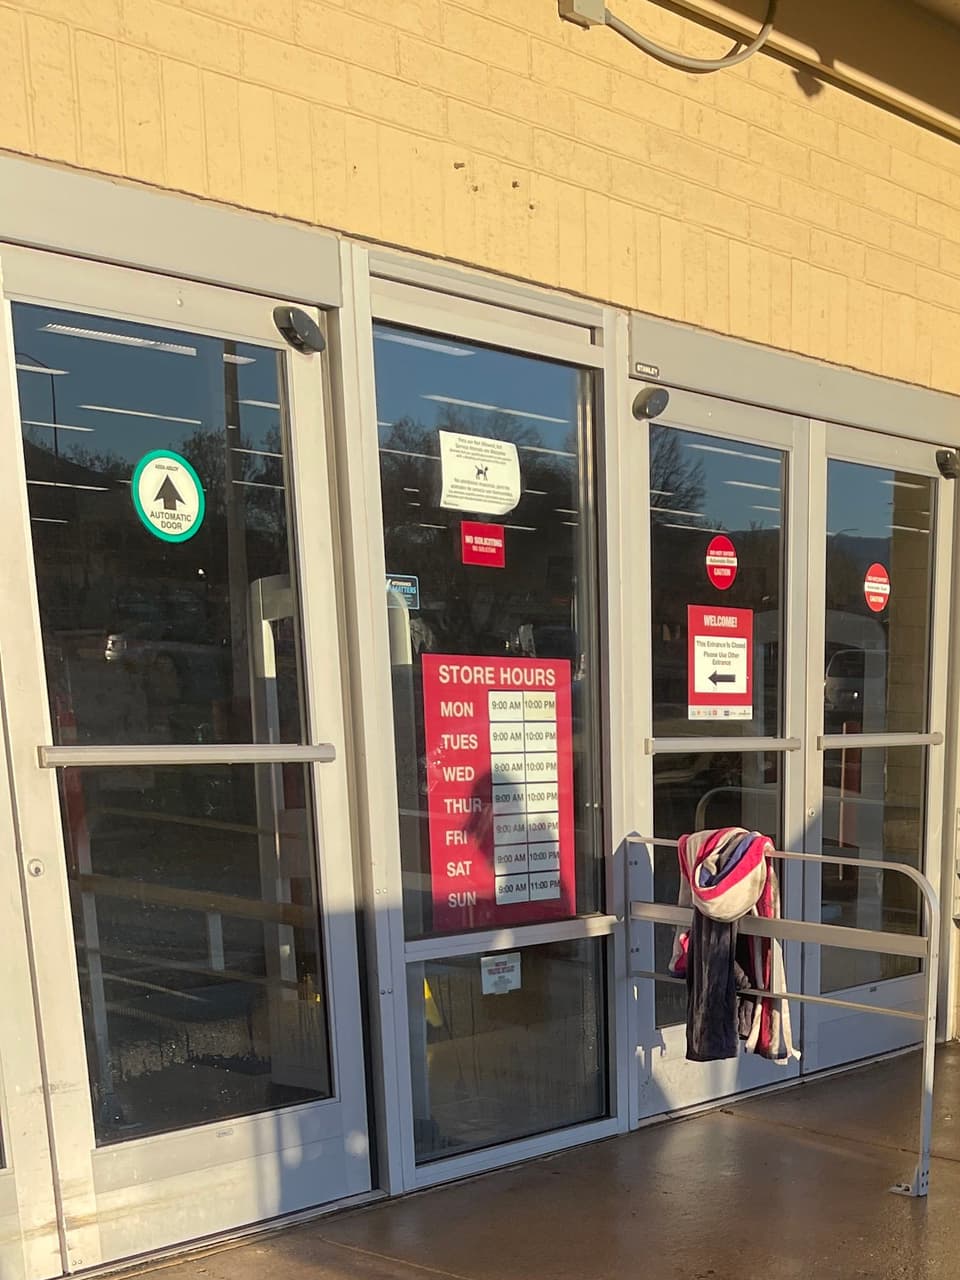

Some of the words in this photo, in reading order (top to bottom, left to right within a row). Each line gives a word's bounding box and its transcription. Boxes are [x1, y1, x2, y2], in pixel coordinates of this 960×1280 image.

[637, 364, 659, 376] STANLEY
[150, 511, 192, 522] AUTOMATIC
[160, 521, 183, 530] DOOR
[464, 535, 474, 544] NO
[474, 536, 502, 548] SOLICITING
[714, 568, 731, 576] CAUTION
[704, 614, 738, 628] WELCOME!
[438, 665, 496, 685] STORE
[500, 667, 556, 686] HOURS
[440, 701, 474, 718] MON
[492, 700, 507, 710] 9:00
[509, 701, 521, 710] AM
[524, 700, 543, 710] 10:00
[544, 701, 555, 709] PM
[441, 734, 478, 750] TUES
[492, 732, 508, 742] 9:00
[510, 732, 522, 741] AM
[526, 732, 544, 741] 10:00
[545, 732, 556, 740] PM
[443, 766, 475, 782] WED
[494, 763, 510, 772] 9:00
[511, 762, 523, 772] AM
[526, 762, 544, 772] 10:00
[546, 762, 557, 770] PM
[444, 798, 482, 814] THUR
[512, 793, 524, 802] AM
[528, 792, 546, 802] 10:00
[546, 792, 558, 801] PM
[445, 830, 468, 846] FRI
[513, 824, 525, 833] AM
[528, 822, 546, 832] 10:00
[547, 820, 559, 830] PM
[446, 861, 472, 878] SAT
[514, 853, 526, 863] AM
[530, 852, 547, 862] 10:00
[548, 850, 560, 860] PM
[448, 890, 476, 908] SUN
[515, 882, 527, 892] AM
[549, 879, 560, 890] PM
